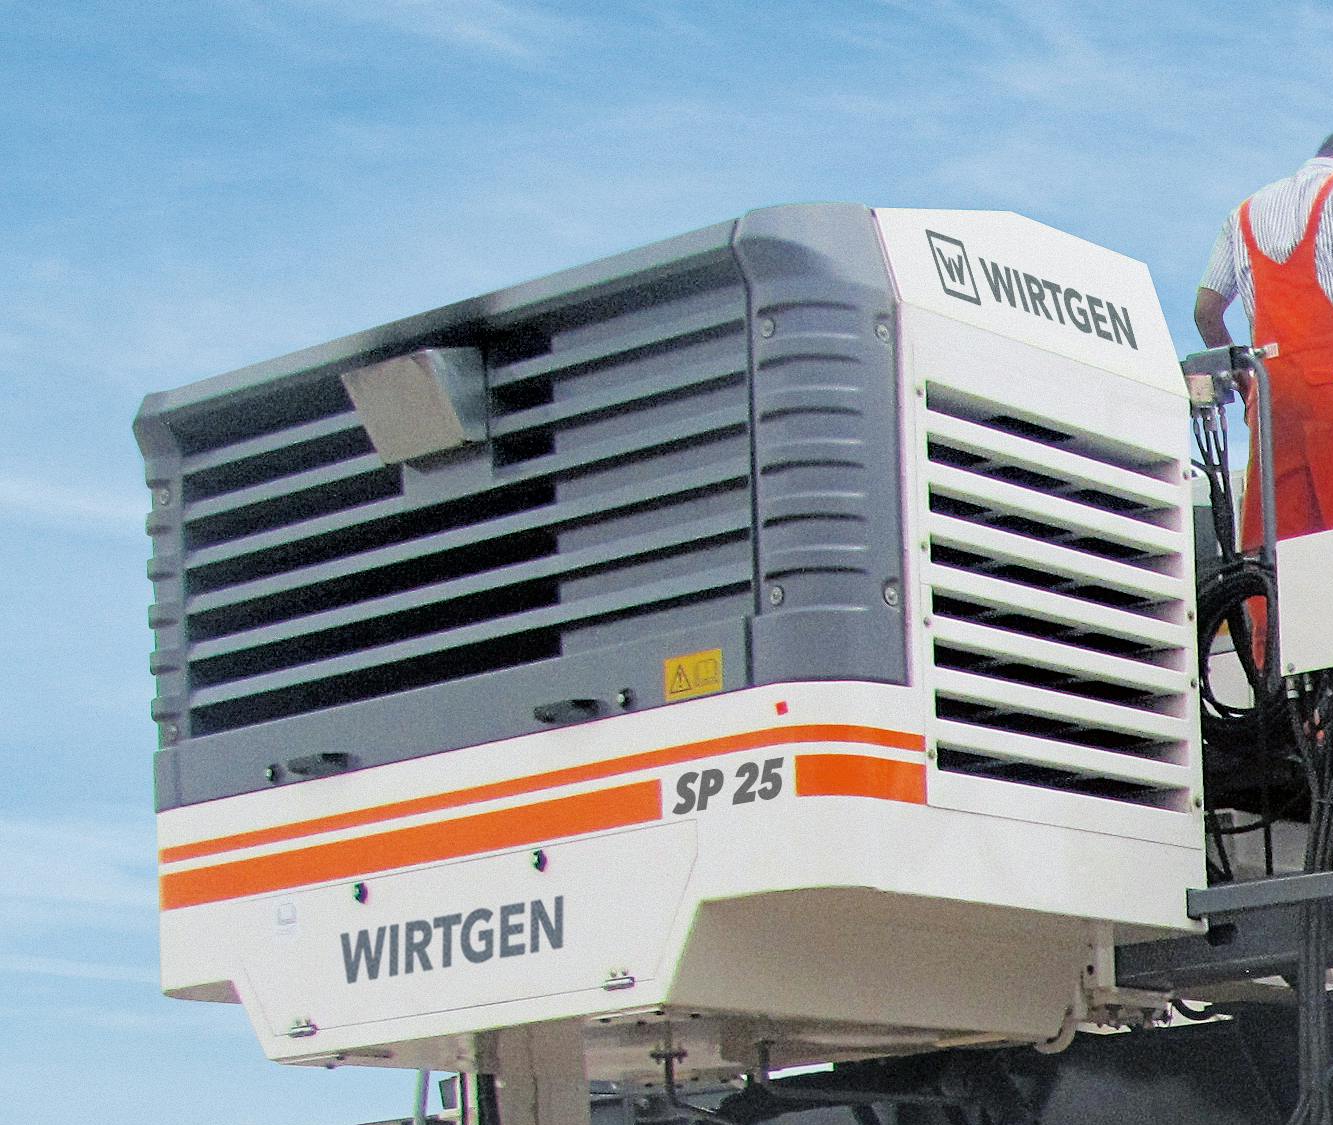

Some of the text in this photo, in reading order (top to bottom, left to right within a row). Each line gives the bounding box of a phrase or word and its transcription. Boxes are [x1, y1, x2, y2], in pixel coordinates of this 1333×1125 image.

[978, 257, 1138, 350] WIRTGEN
[672, 757, 784, 815] SP 25
[340, 896, 564, 984] WIRTGEN
